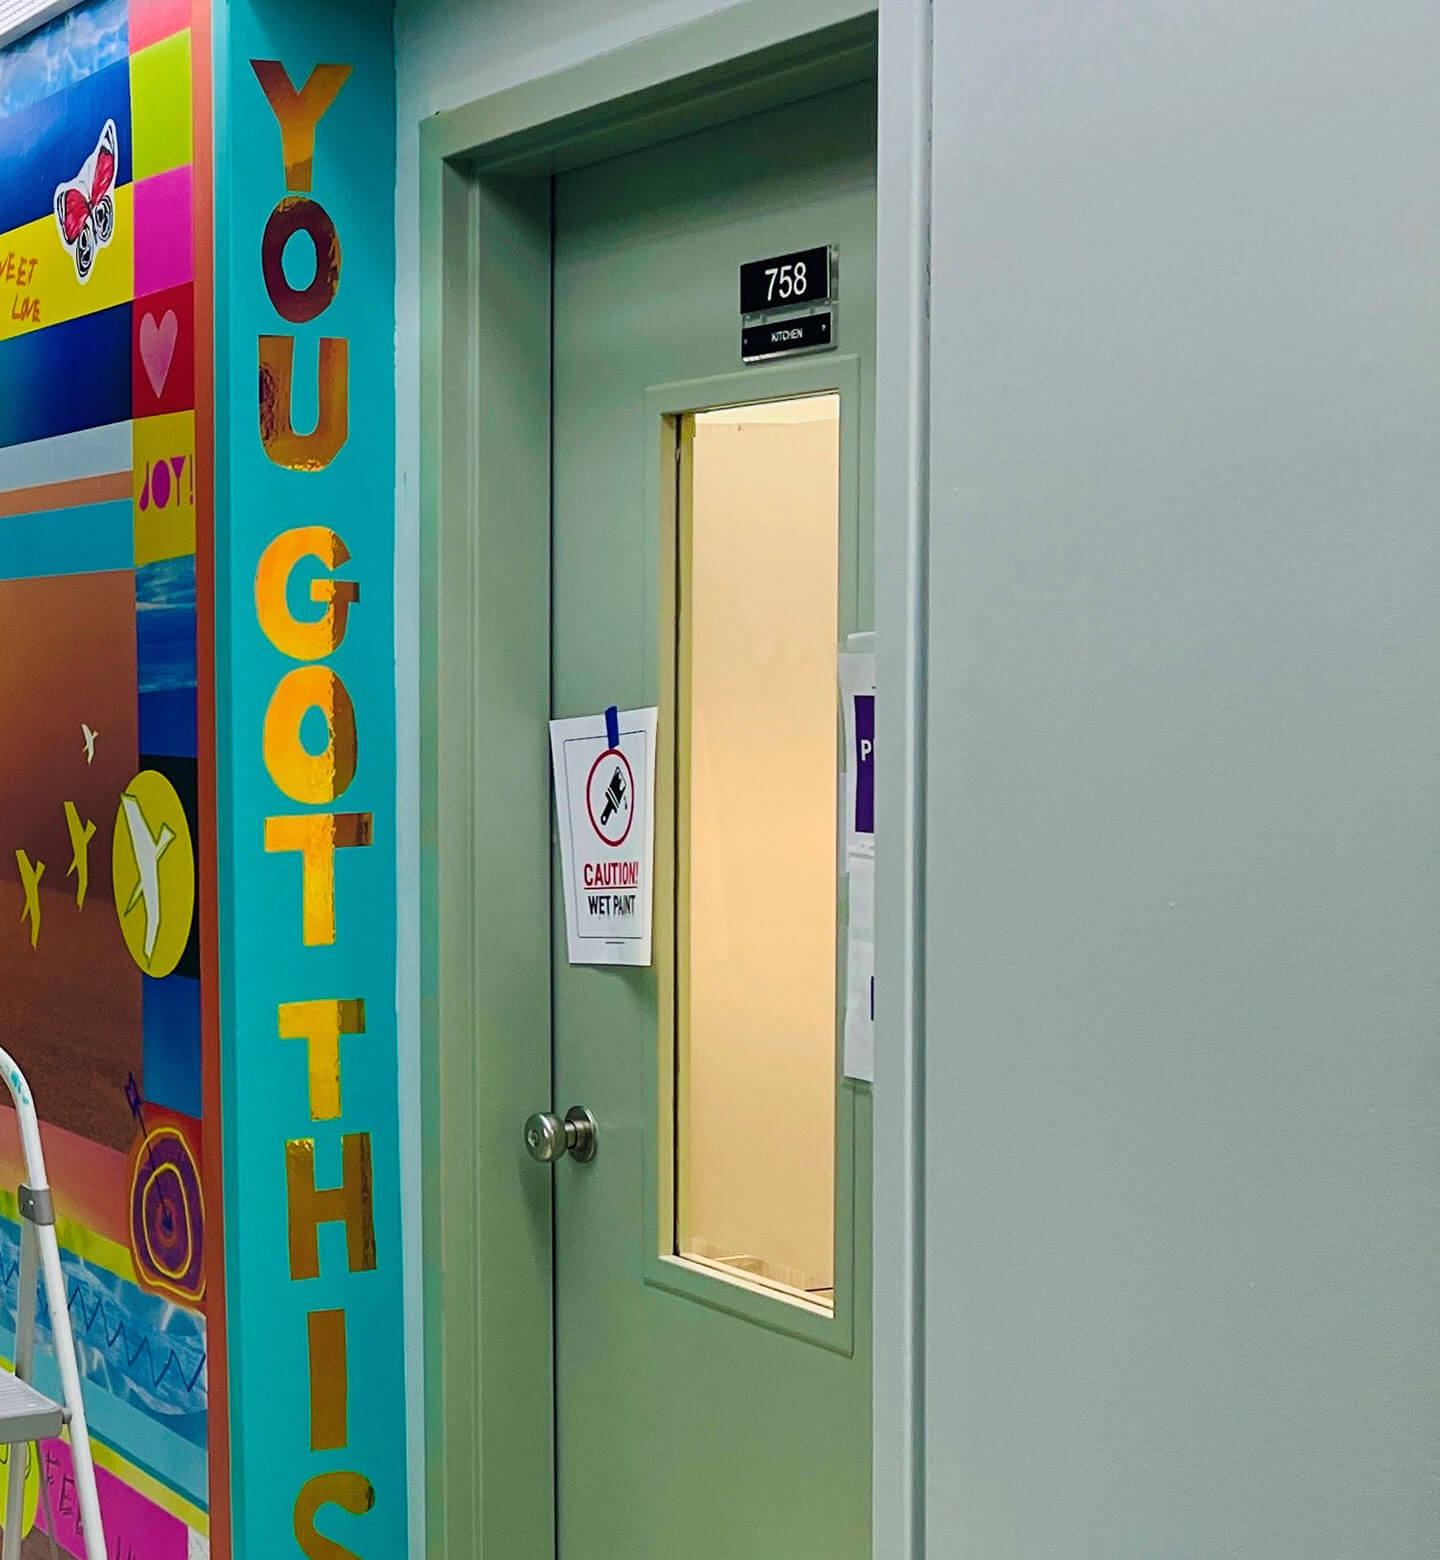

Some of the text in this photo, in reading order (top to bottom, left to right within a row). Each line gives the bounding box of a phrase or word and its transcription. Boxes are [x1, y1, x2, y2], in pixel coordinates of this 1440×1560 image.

[249, 58, 355, 472] YOU
[764, 261, 807, 301] 758
[771, 327, 803, 343] KITCHEN
[139, 454, 194, 512] JOY!
[254, 526, 374, 947] GOT
[583, 861, 638, 886] CAUTION!
[587, 894, 636, 916] WET PAINT
